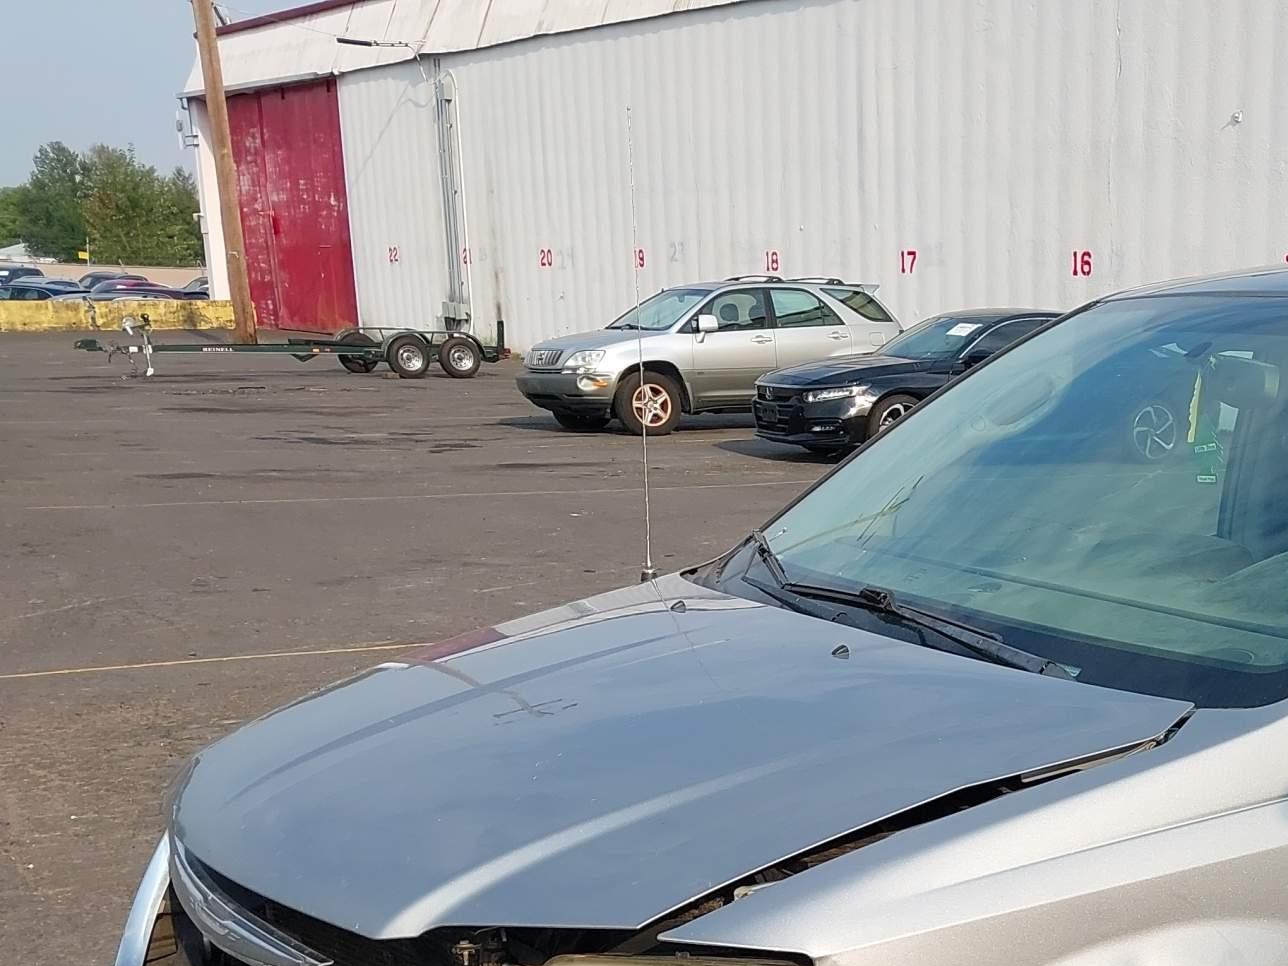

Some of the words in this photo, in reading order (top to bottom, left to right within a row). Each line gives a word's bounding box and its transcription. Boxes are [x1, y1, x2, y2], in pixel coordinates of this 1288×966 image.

[388, 246, 399, 263] 22
[539, 248, 553, 267] 20
[633, 248, 646, 269] 19
[765, 250, 780, 272] 18
[900, 250, 918, 274] 17
[1072, 250, 1092, 277] 16
